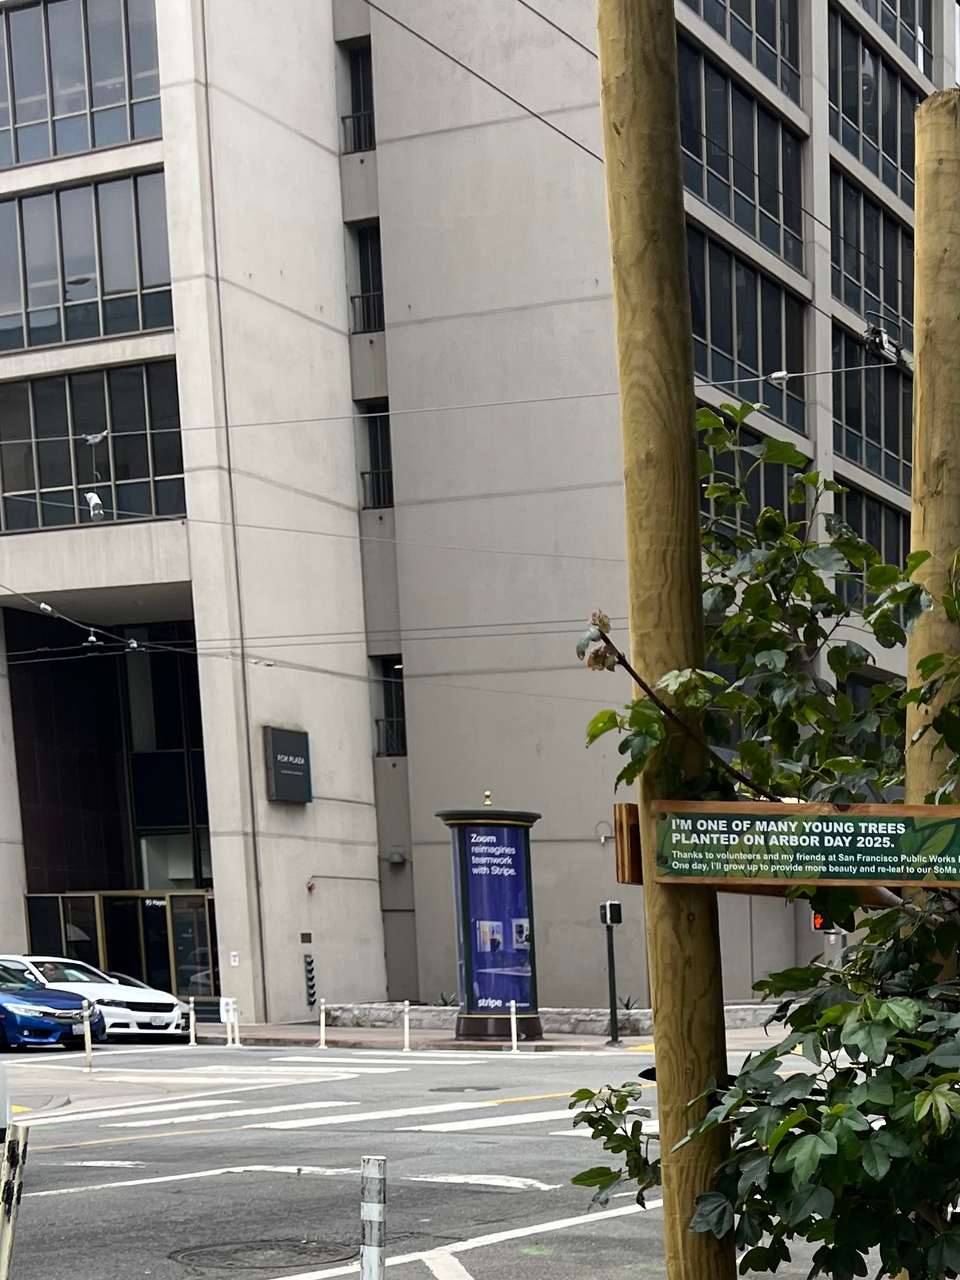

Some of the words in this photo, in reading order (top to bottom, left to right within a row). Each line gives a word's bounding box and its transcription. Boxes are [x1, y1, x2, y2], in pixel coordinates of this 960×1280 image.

[671, 819, 692, 830] I'M
[696, 820, 728, 831] ONE
[731, 820, 751, 831] OF
[755, 821, 798, 832] MANY
[802, 821, 855, 833] YOUNG
[859, 822, 906, 834] TREES
[471, 833, 497, 843] Zoom
[671, 833, 739, 845] PLANTED
[743, 834, 765, 846] ON
[769, 835, 820, 847] ARBOR
[824, 836, 852, 847] DAY
[856, 836, 895, 848] 2025.
[471, 845, 516, 856] reimagines
[672, 850, 703, 860] Thanks
[705, 851, 714, 860] to
[716, 852, 761, 860] volunteers
[763, 852, 779, 861] and
[781, 853, 794, 862] my
[796, 852, 826, 861] friends
[828, 853, 836, 861] at
[838, 853, 855, 862] San
[857, 853, 899, 862] Francisco
[900, 854, 927, 863] Public
[929, 854, 956, 863] Works
[471, 855, 512, 865] teamwork
[472, 866, 490, 875] with
[672, 861, 689, 870] One
[691, 862, 709, 871] day,
[723, 864, 745, 872] grow
[747, 864, 758, 872] up
[760, 863, 769, 871] to
[770, 863, 803, 873] provide
[828, 864, 857, 874] beauty
[859, 864, 876, 873] and
[877, 865, 905, 874] re-leaf
[906, 866, 915, 874] to
[933, 866, 957, 874] SoMa
[478, 997, 502, 1009] stripe
